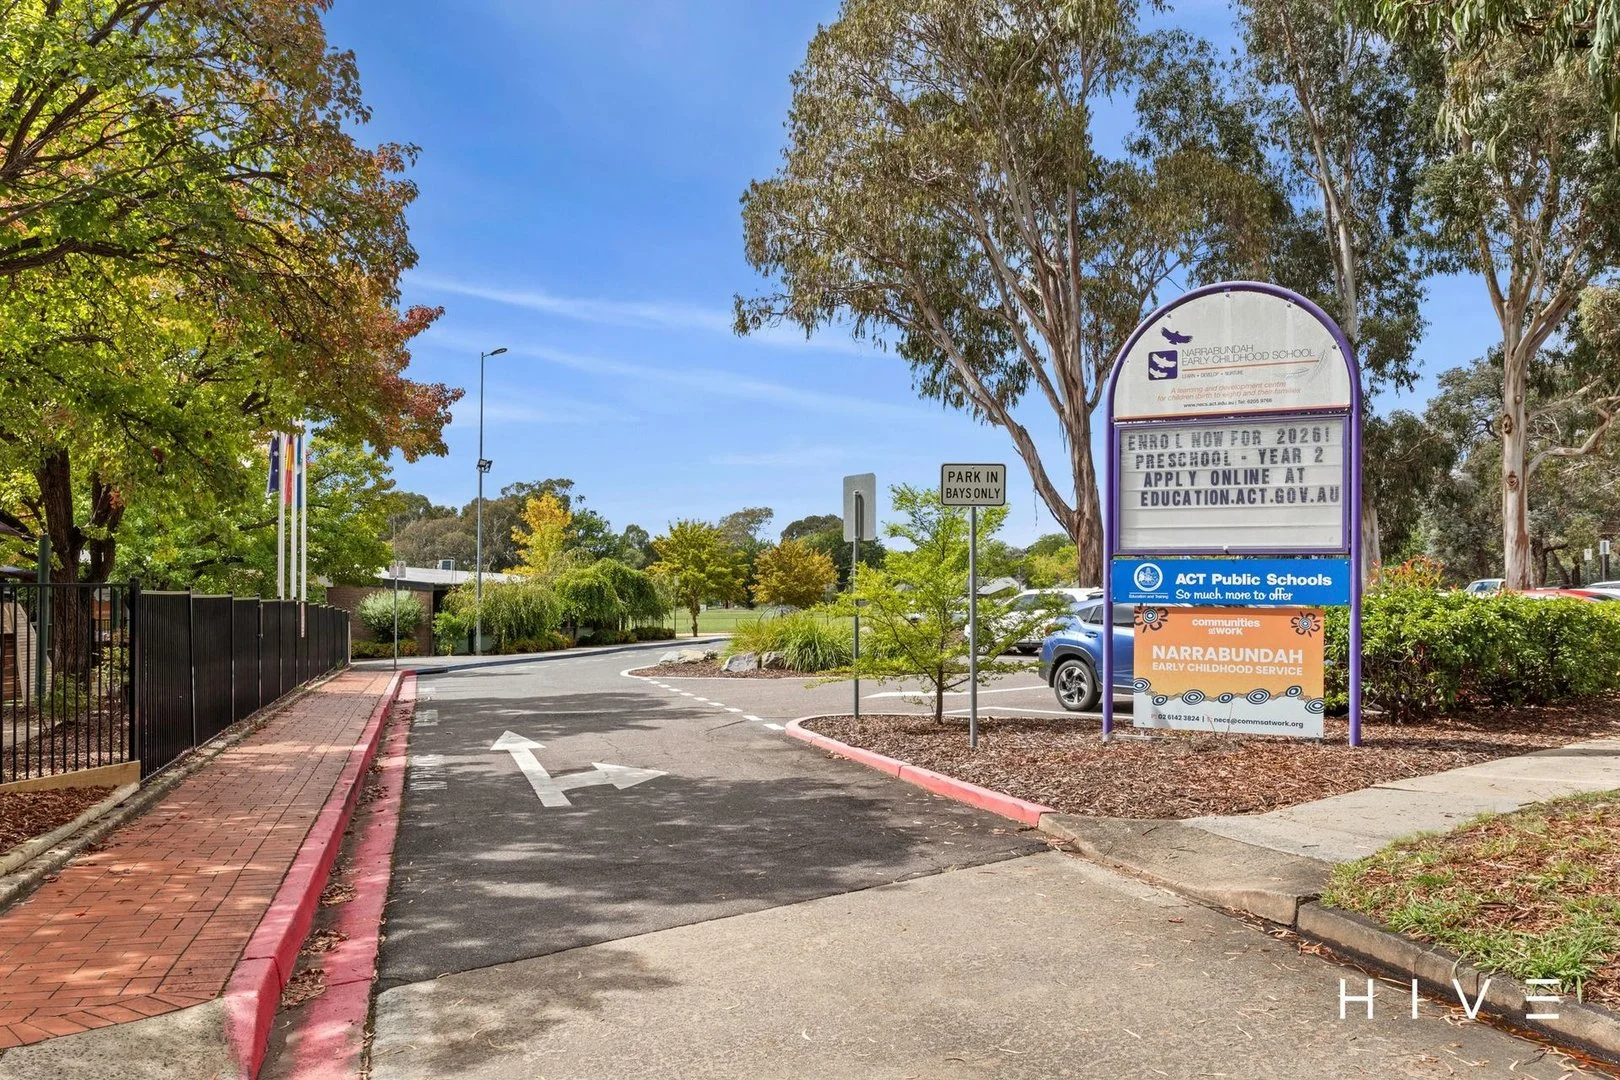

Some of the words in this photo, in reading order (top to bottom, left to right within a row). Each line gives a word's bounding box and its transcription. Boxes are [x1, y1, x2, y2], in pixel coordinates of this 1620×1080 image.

[1182, 344, 1254, 357] NARRABUNDAH
[1182, 355, 1210, 366] EARLY
[1212, 351, 1269, 364] CHILDHOOD
[1272, 348, 1315, 360] SCHOOL
[1219, 382, 1263, 391] development
[1128, 433, 1183, 451] ENROL
[1192, 431, 1224, 448] NOW
[1231, 430, 1262, 447] FOR
[1276, 426, 1330, 445] 2026!
[1135, 450, 1232, 469] PRESCHOOL
[1258, 448, 1302, 465] YEAR
[1314, 447, 1324, 463] 2
[948, 471, 981, 483] PARK
[986, 471, 998, 483] IN
[1144, 470, 1197, 488] APPLY
[1210, 468, 1270, 486] ONLINE
[1285, 467, 1305, 484] AT
[946, 487, 972, 499] BAYS
[973, 487, 1001, 499] ONLY
[1140, 486, 1340, 507] EDUCATION.ACT.GOV.AU
[1175, 573, 1206, 585] ACT
[1211, 573, 1260, 585] Public
[1266, 573, 1332, 586] Schools
[1175, 588, 1191, 600] So
[1193, 587, 1223, 600] much
[1225, 591, 1251, 600] more
[1253, 589, 1266, 601] to
[1269, 587, 1293, 601] offer
[1192, 617, 1261, 628] communities
[1152, 645, 1303, 664] NARRABUNDAH
[1152, 662, 1185, 672] EARLY
[1187, 663, 1252, 674] CHILDHOOD
[1256, 665, 1303, 676] SERVICE
